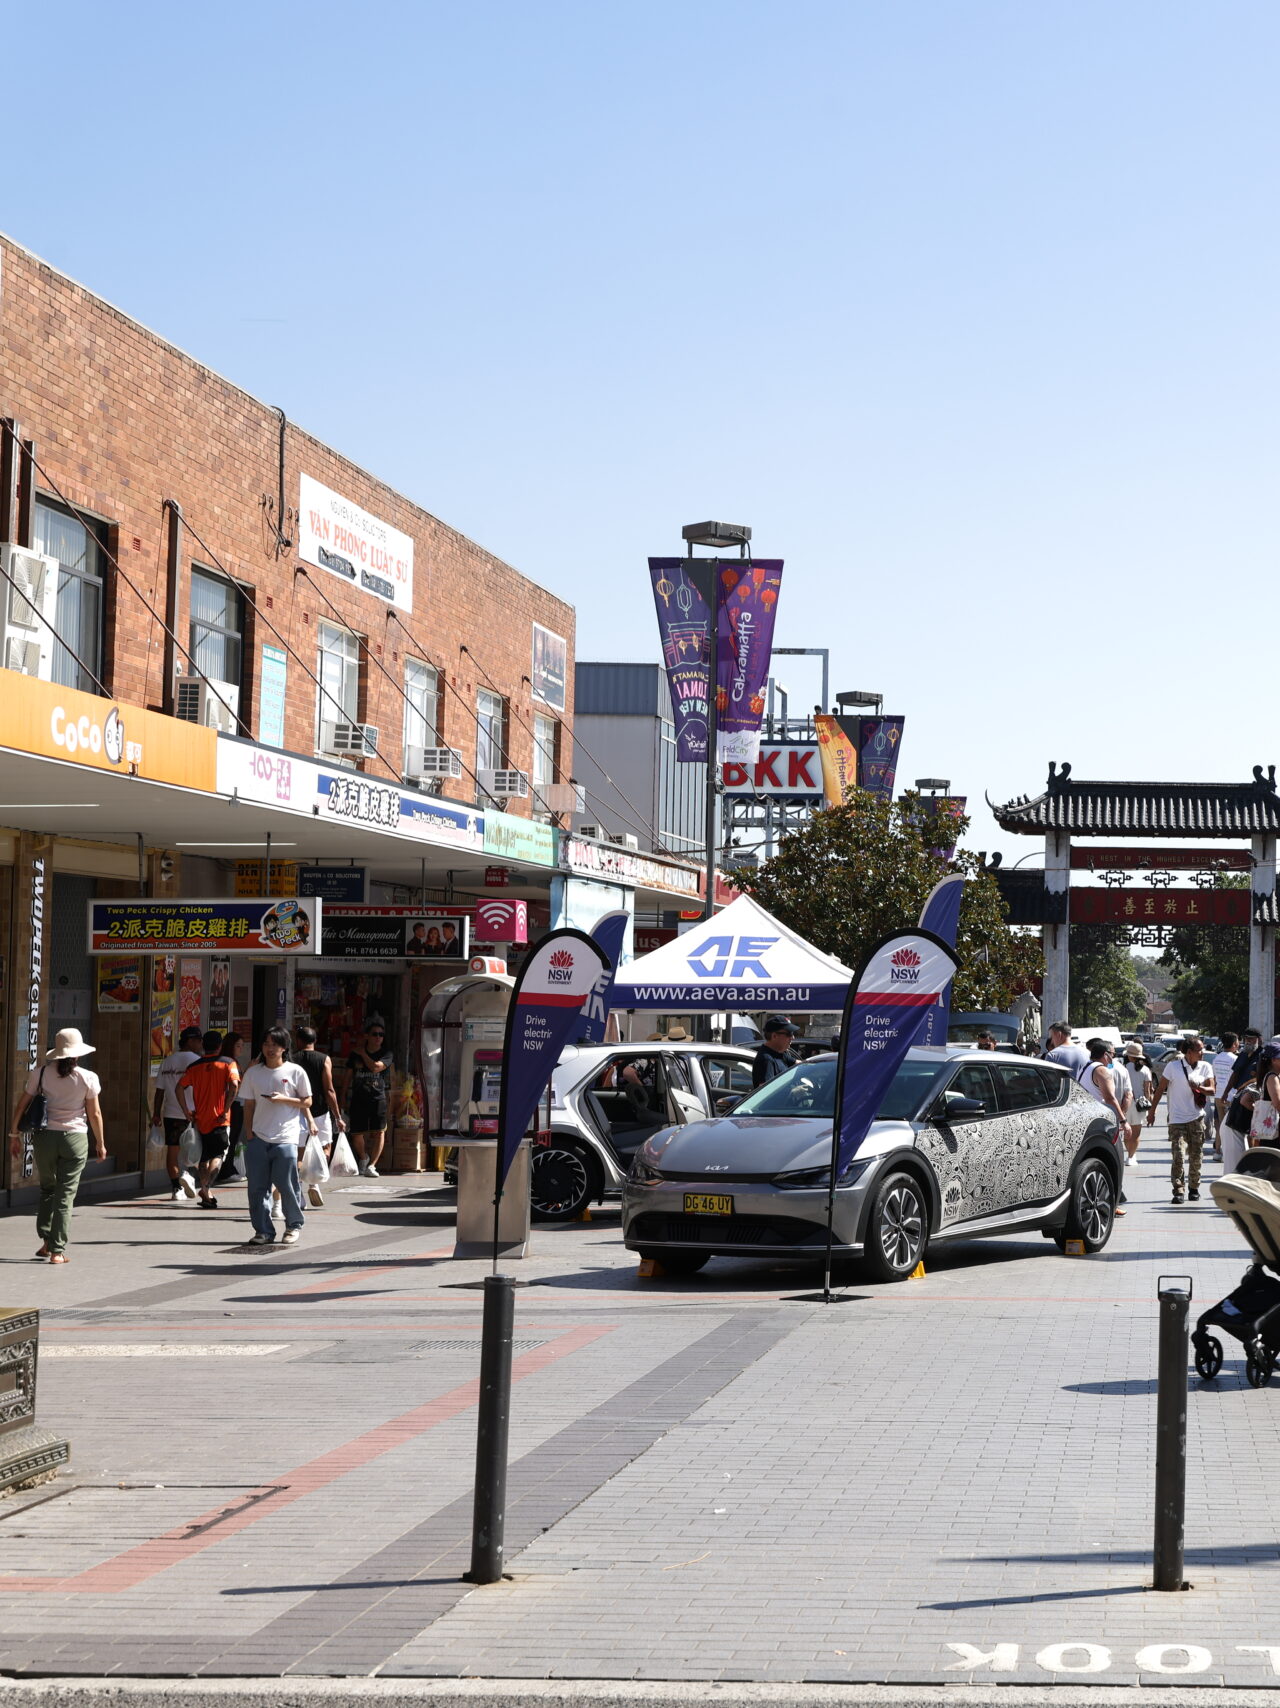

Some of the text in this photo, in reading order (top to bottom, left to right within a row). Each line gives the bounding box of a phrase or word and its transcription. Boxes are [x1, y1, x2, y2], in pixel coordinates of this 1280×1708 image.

[732, 612, 756, 702] Cabramatta
[51, 706, 102, 753] CoCo
[723, 751, 817, 788] BKK
[32, 858, 45, 920] TWO
[150, 906, 178, 916] Crispy
[180, 906, 213, 914] Chicken
[108, 918, 250, 938] 2派克脆皮雞排
[339, 927, 401, 943] Management
[100, 941, 136, 950] Originated
[360, 947, 378, 955] 8764
[379, 947, 398, 955] 6639
[548, 969, 573, 981] NSW
[890, 968, 920, 980] NSW
[633, 986, 810, 1001] www.aeva.asn.au
[525, 1014, 547, 1026] Drive
[865, 1014, 891, 1026] Drive
[27, 983, 40, 1073] CRISPY
[523, 1040, 544, 1051] NSW
[862, 1040, 888, 1051] NSW
[685, 1195, 730, 1211] DG 46 UY
